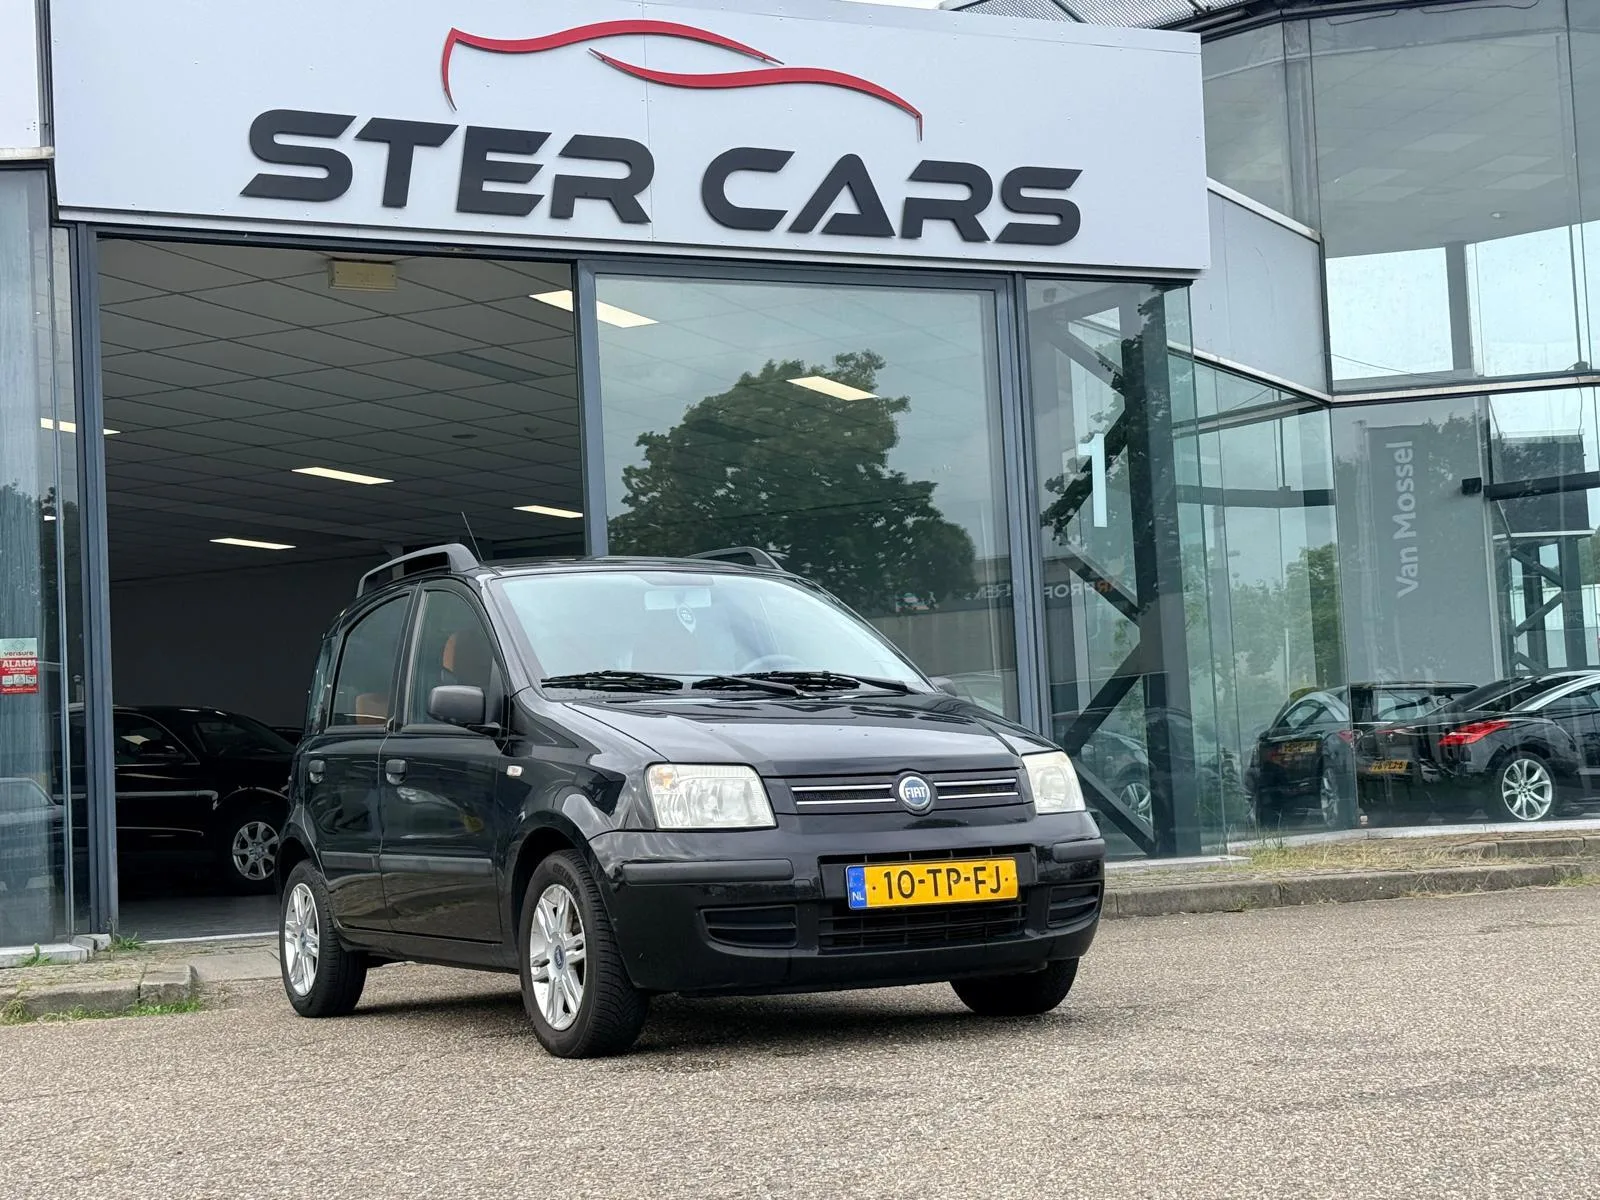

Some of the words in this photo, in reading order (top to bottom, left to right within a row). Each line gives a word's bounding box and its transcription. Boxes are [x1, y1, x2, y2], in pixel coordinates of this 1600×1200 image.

[239, 109, 655, 224] STER
[701, 147, 1083, 246] CARS
[1384, 441, 1417, 540] Mossel
[1396, 546, 1419, 598] Van
[2, 659, 37, 668] ALARM
[904, 786, 927, 799] FIAT
[852, 891, 865, 901] NL
[883, 866, 1001, 899] 10-TP-FJ
